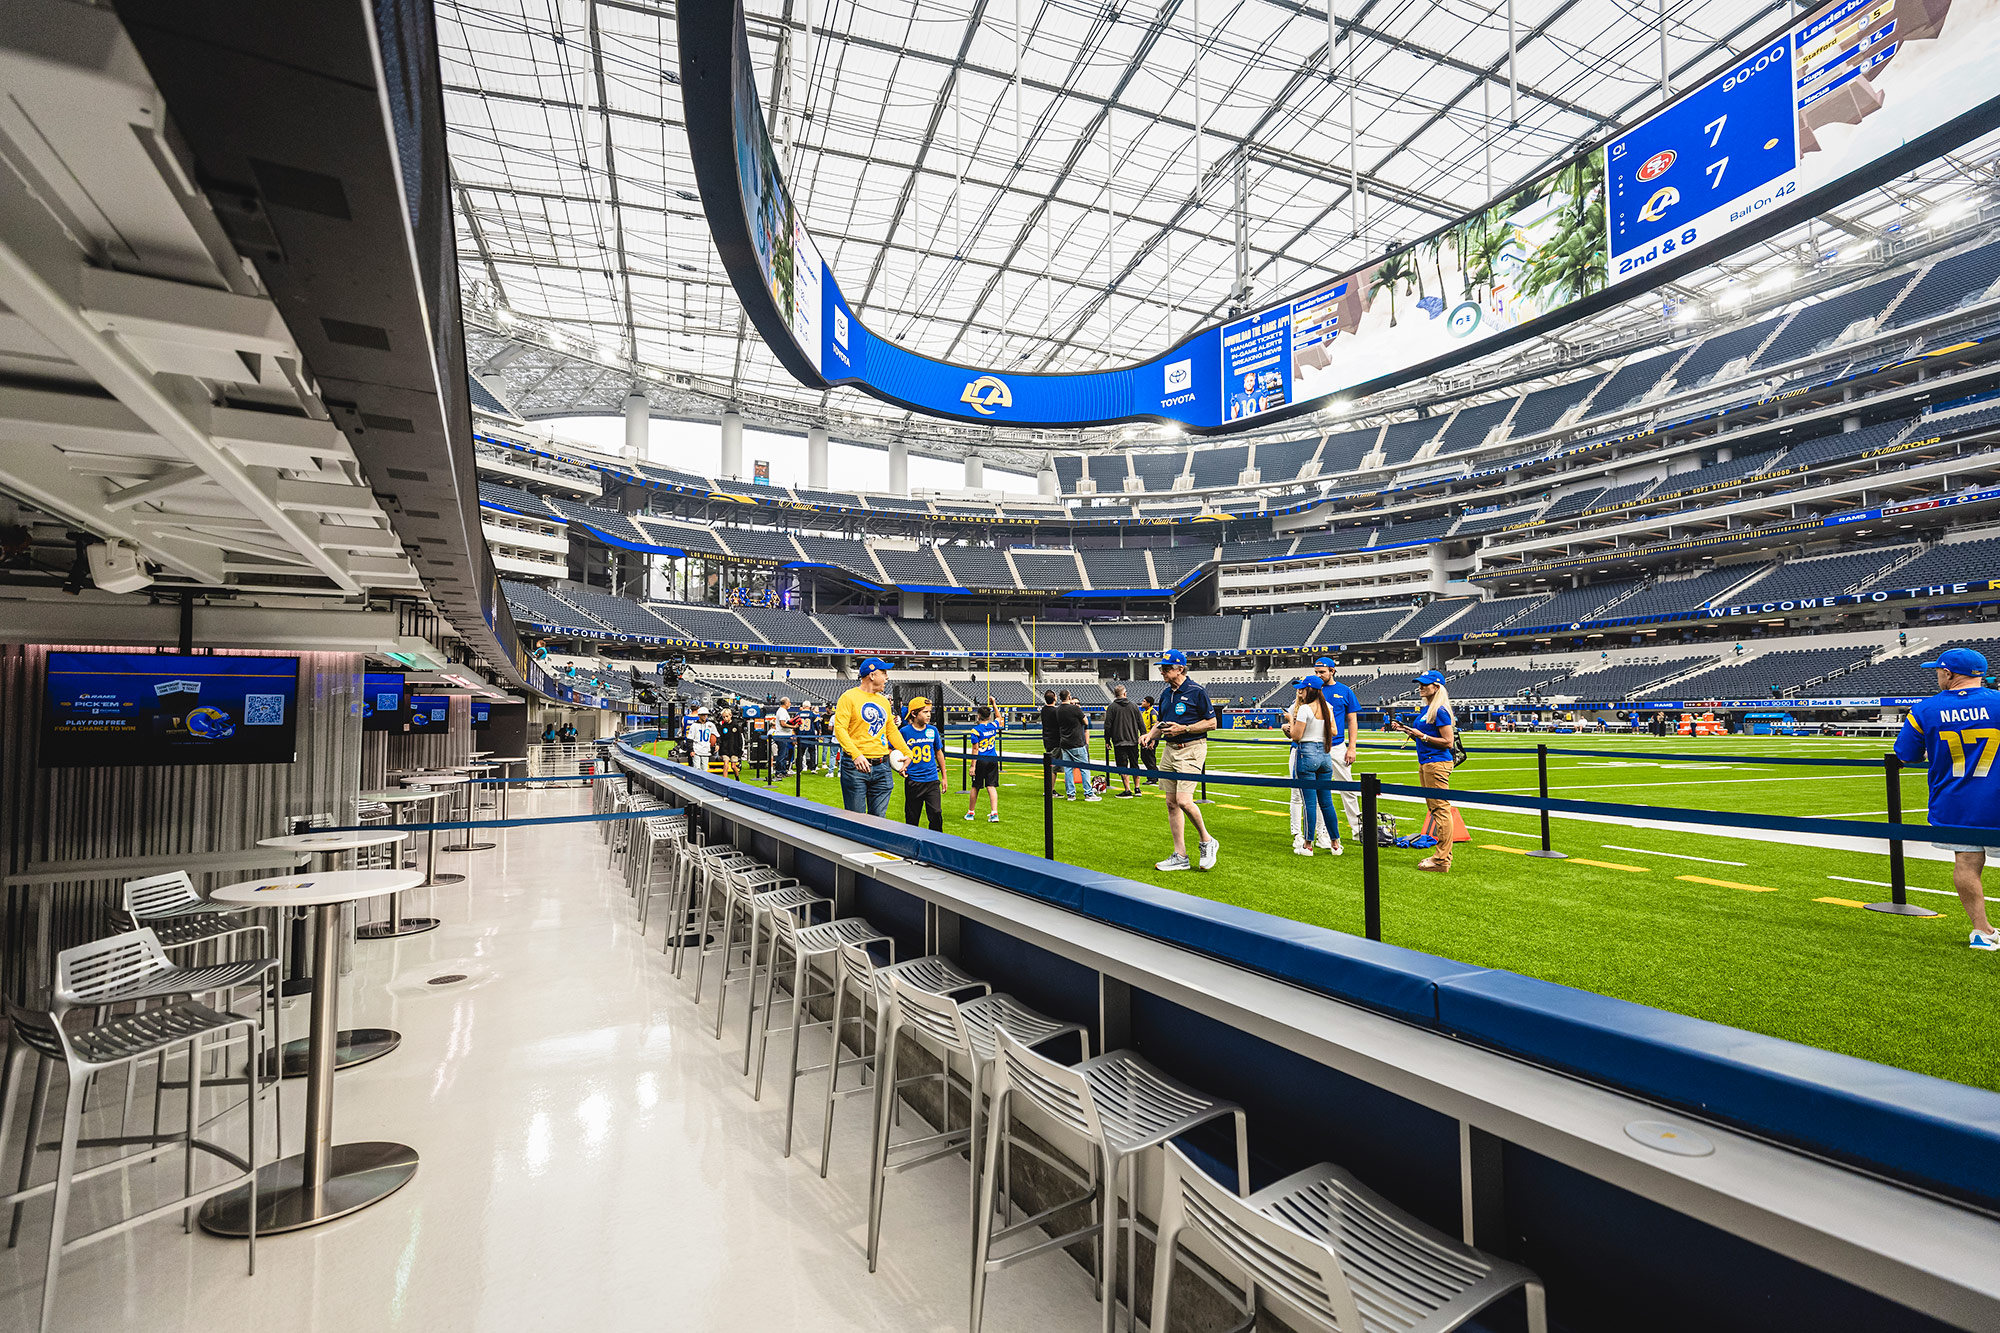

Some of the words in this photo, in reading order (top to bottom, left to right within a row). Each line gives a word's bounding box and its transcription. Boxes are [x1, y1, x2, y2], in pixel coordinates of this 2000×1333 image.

[1803, 38, 1837, 63] Stafford
[1873, 9, 1881, 19] 5
[1722, 46, 1785, 93] 90:00
[1803, 68, 1825, 84] Kupp
[1874, 31, 1883, 41] 4
[1875, 53, 1884, 63] 4
[1704, 114, 1728, 148] 7
[1705, 156, 1729, 190] 7
[1730, 205, 1752, 222] Ball
[1753, 197, 1772, 210] On
[1775, 181, 1796, 199] 42
[1619, 246, 1658, 275] 2nd
[1662, 239, 1676, 255] &
[1681, 228, 1697, 246] 8
[1295, 290, 1335, 311] Leaderboard
[1230, 340, 1257, 353] MANAGE
[1257, 330, 1284, 344] TICKETS
[1231, 348, 1257, 360] IN-GAME
[1258, 338, 1283, 351] ALERTS
[832, 342, 851, 368] TOYOTA
[1232, 352, 1263, 367] BREAKING
[1263, 346, 1282, 357] NEWS
[1160, 392, 1196, 409] TOYOTA
[1455, 466, 1514, 481] WELCOME
[1520, 460, 1534, 468] TO
[1541, 453, 1563, 463] THE
[1569, 442, 1612, 456] ROYAL
[1618, 429, 1655, 443] TOUR
[1903, 437, 1941, 449] TOUR
[1595, 504, 1619, 514] ANGELES
[1640, 497, 1655, 505] 2024
[1658, 491, 1682, 501] SEASON
[1692, 485, 1709, 494] SOFI
[952, 516, 1004, 524] ANGELES
[1838, 513, 1867, 523] RAMS
[1708, 597, 1836, 618] WELCOME
[1852, 591, 1888, 603] TO
[1905, 583, 1968, 599] THE
[542, 625, 607, 640] WELCOME
[612, 633, 628, 642] TO
[635, 635, 661, 644] THE
[666, 638, 708, 648] ROYAL
[714, 642, 750, 651] TOUR
[1940, 707, 1990, 723] NACUA
[912, 744, 931, 764] 99
[978, 735, 996, 753] 99
[1938, 728, 2000, 778] 17
